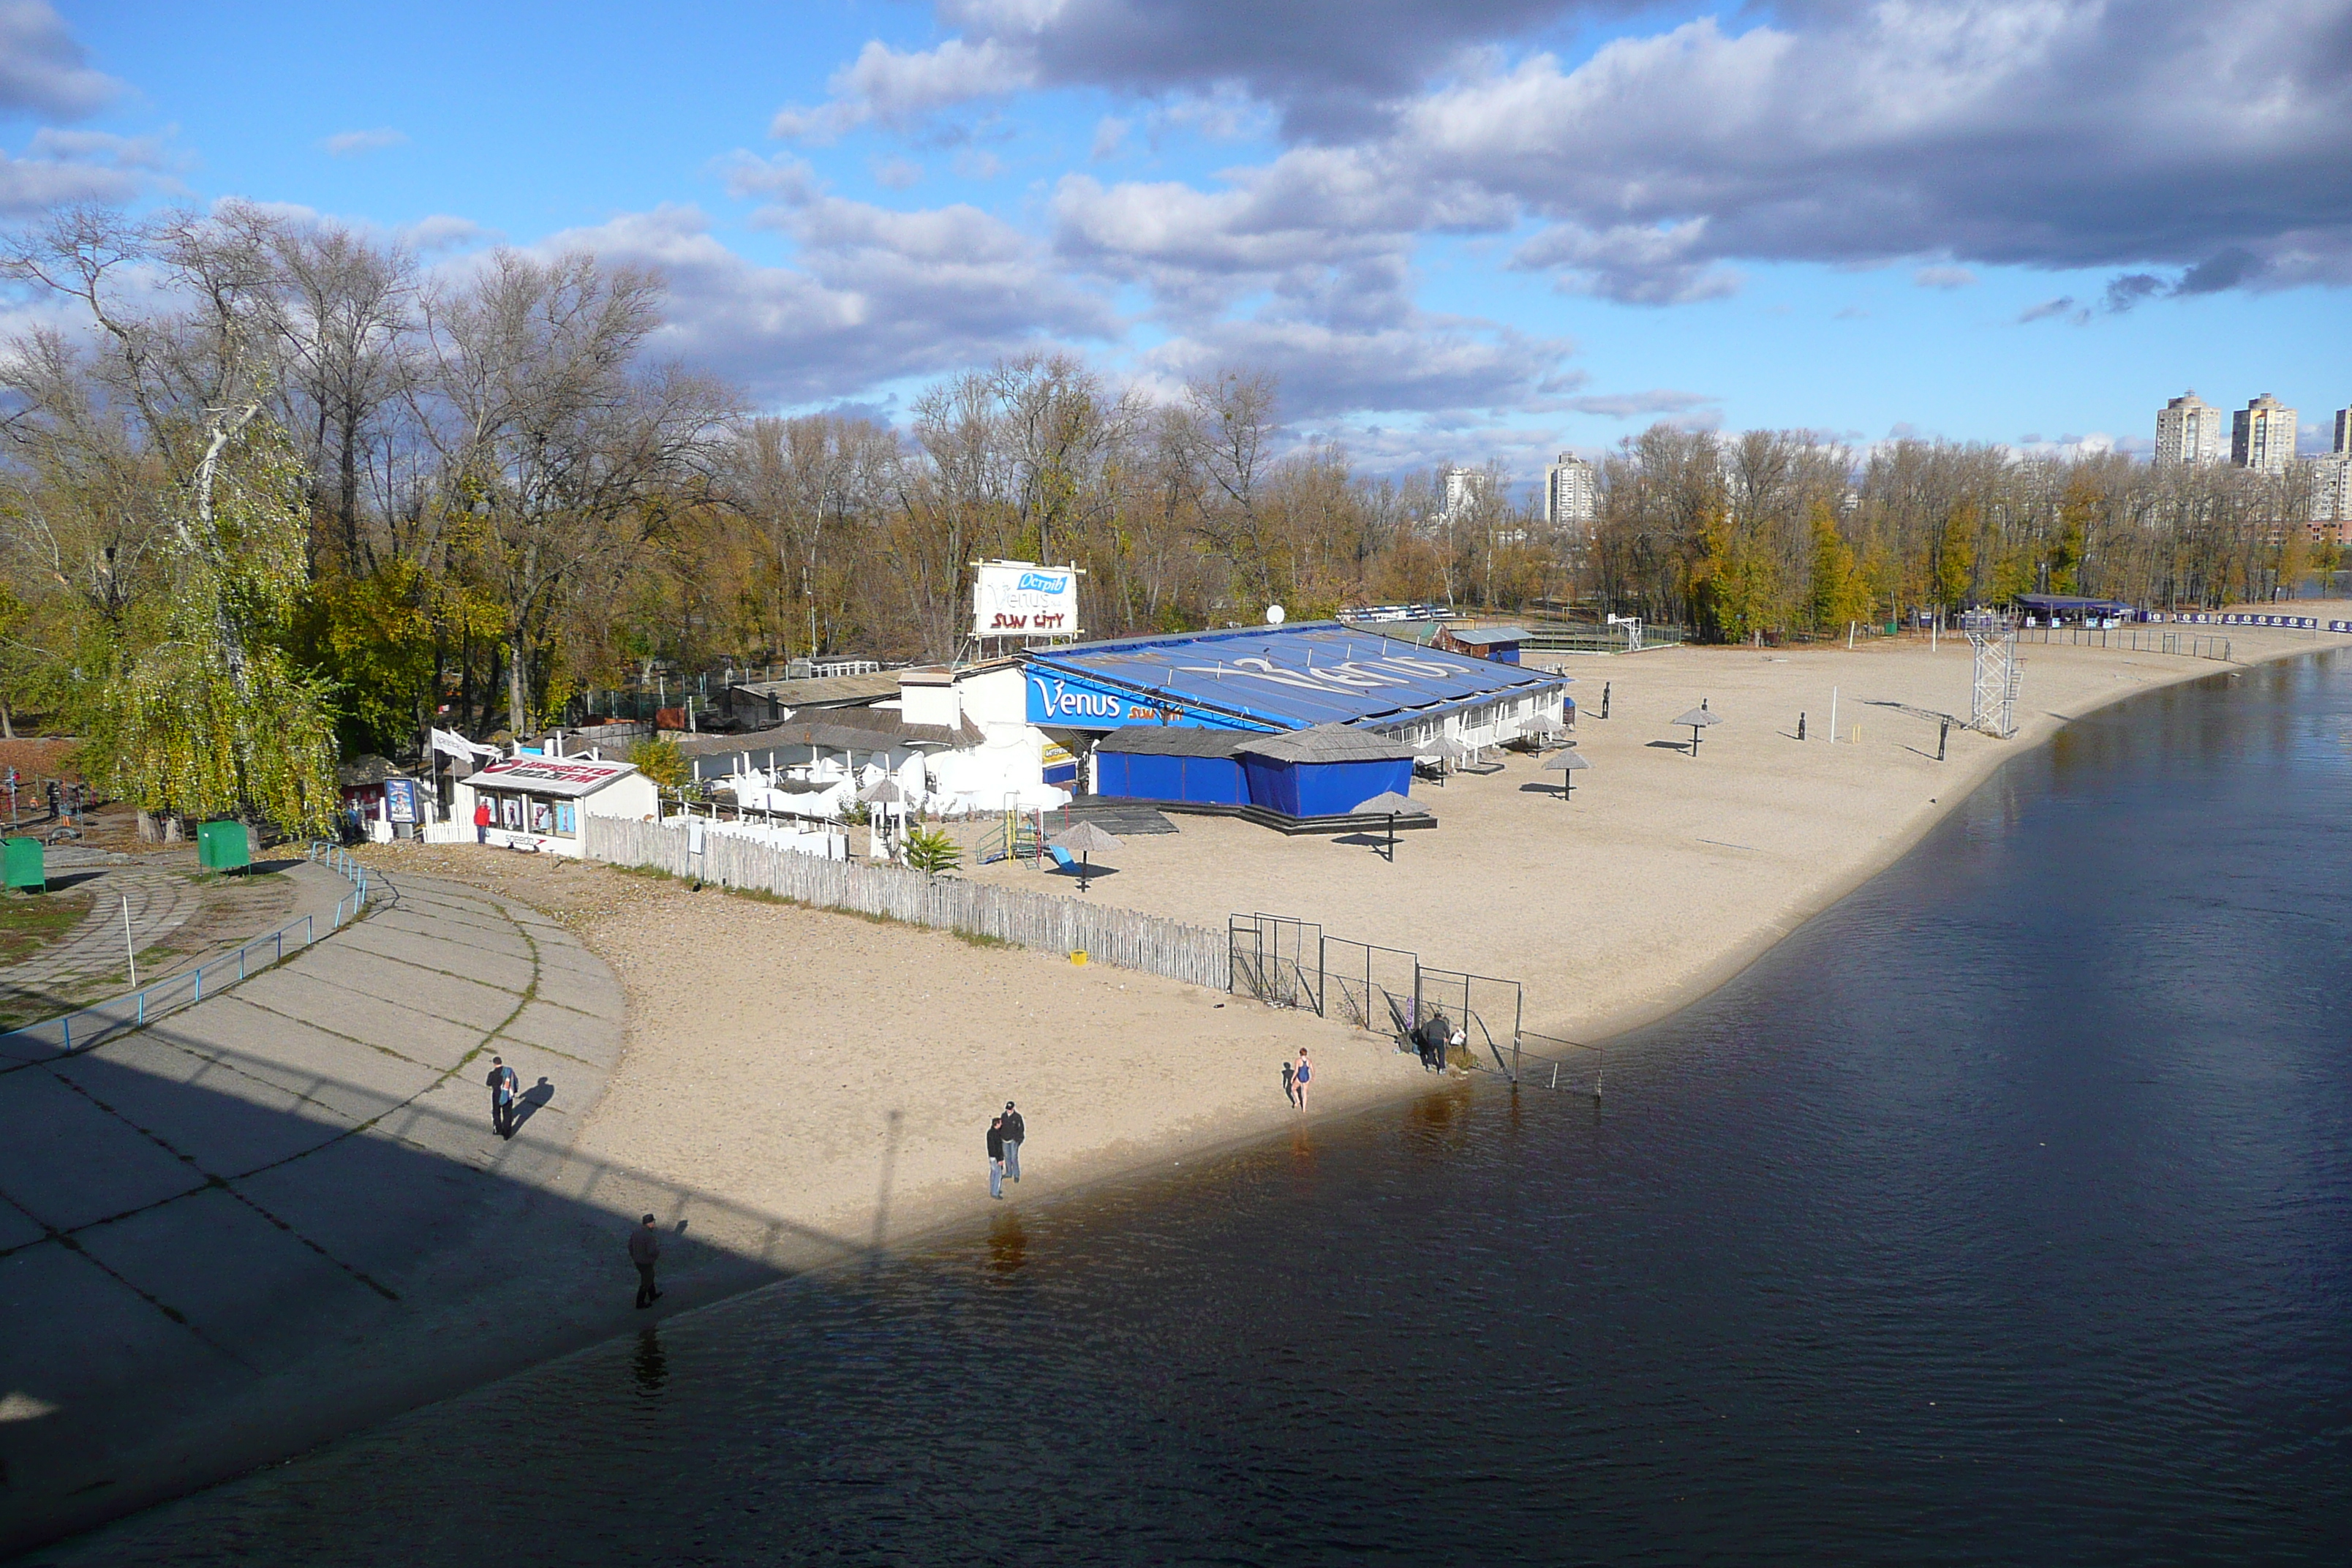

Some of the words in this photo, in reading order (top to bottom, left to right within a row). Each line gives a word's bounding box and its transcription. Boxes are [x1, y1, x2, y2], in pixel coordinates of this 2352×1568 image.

[987, 584, 1050, 611] Venus
[990, 612, 1028, 628] SUN
[1175, 656, 1471, 697] Venus
[1033, 677, 1121, 717] Venus
